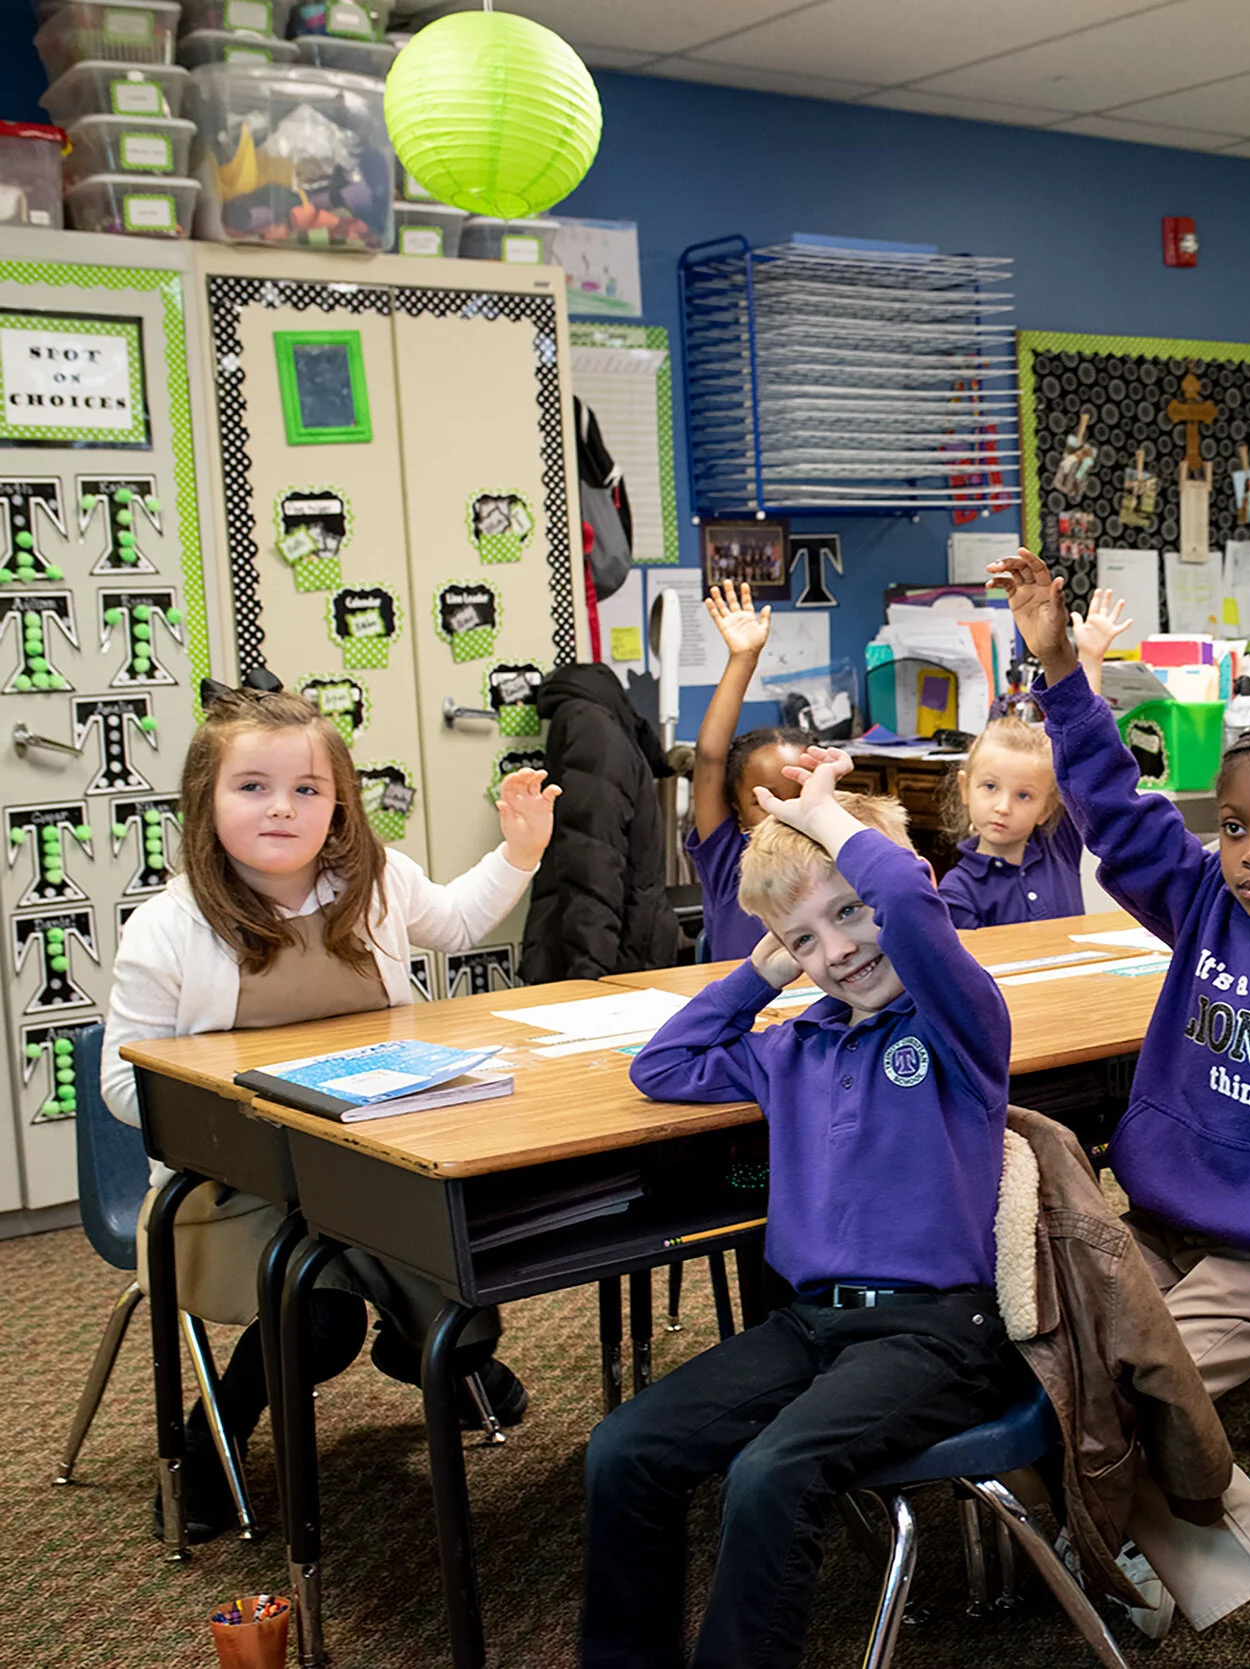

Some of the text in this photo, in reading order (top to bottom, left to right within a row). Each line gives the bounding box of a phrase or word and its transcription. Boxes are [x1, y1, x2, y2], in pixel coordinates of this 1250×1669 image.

[28, 346, 102, 364] SPOT
[9, 392, 127, 410] CHOICES
[1195, 949, 1249, 996] It's a
